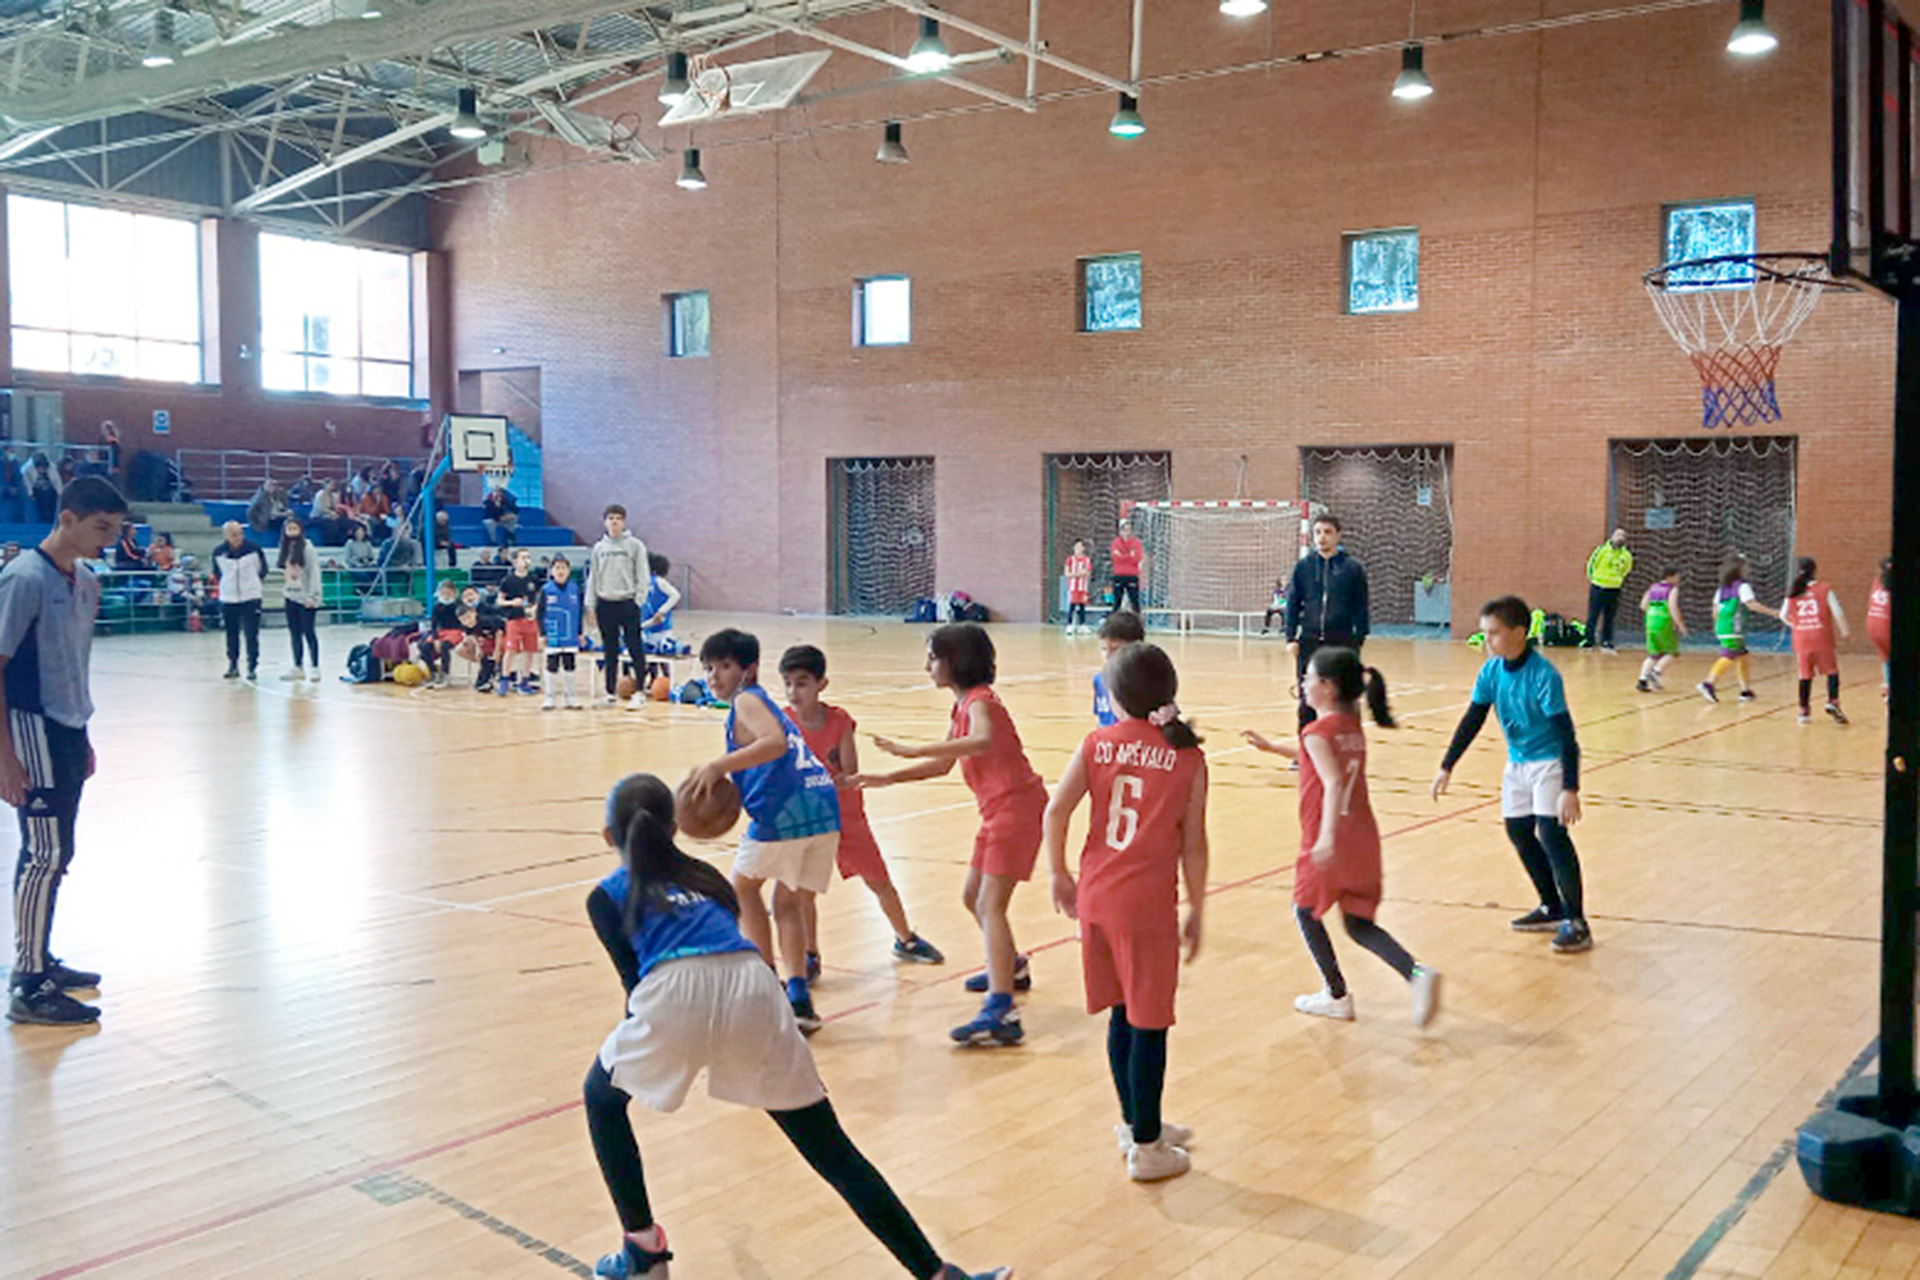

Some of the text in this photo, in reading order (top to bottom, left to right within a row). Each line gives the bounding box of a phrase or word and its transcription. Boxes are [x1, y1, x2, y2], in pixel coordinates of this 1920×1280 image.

[1796, 599, 1819, 616] 23
[1105, 774, 1144, 851] 6
[1340, 759, 1360, 816] 7
